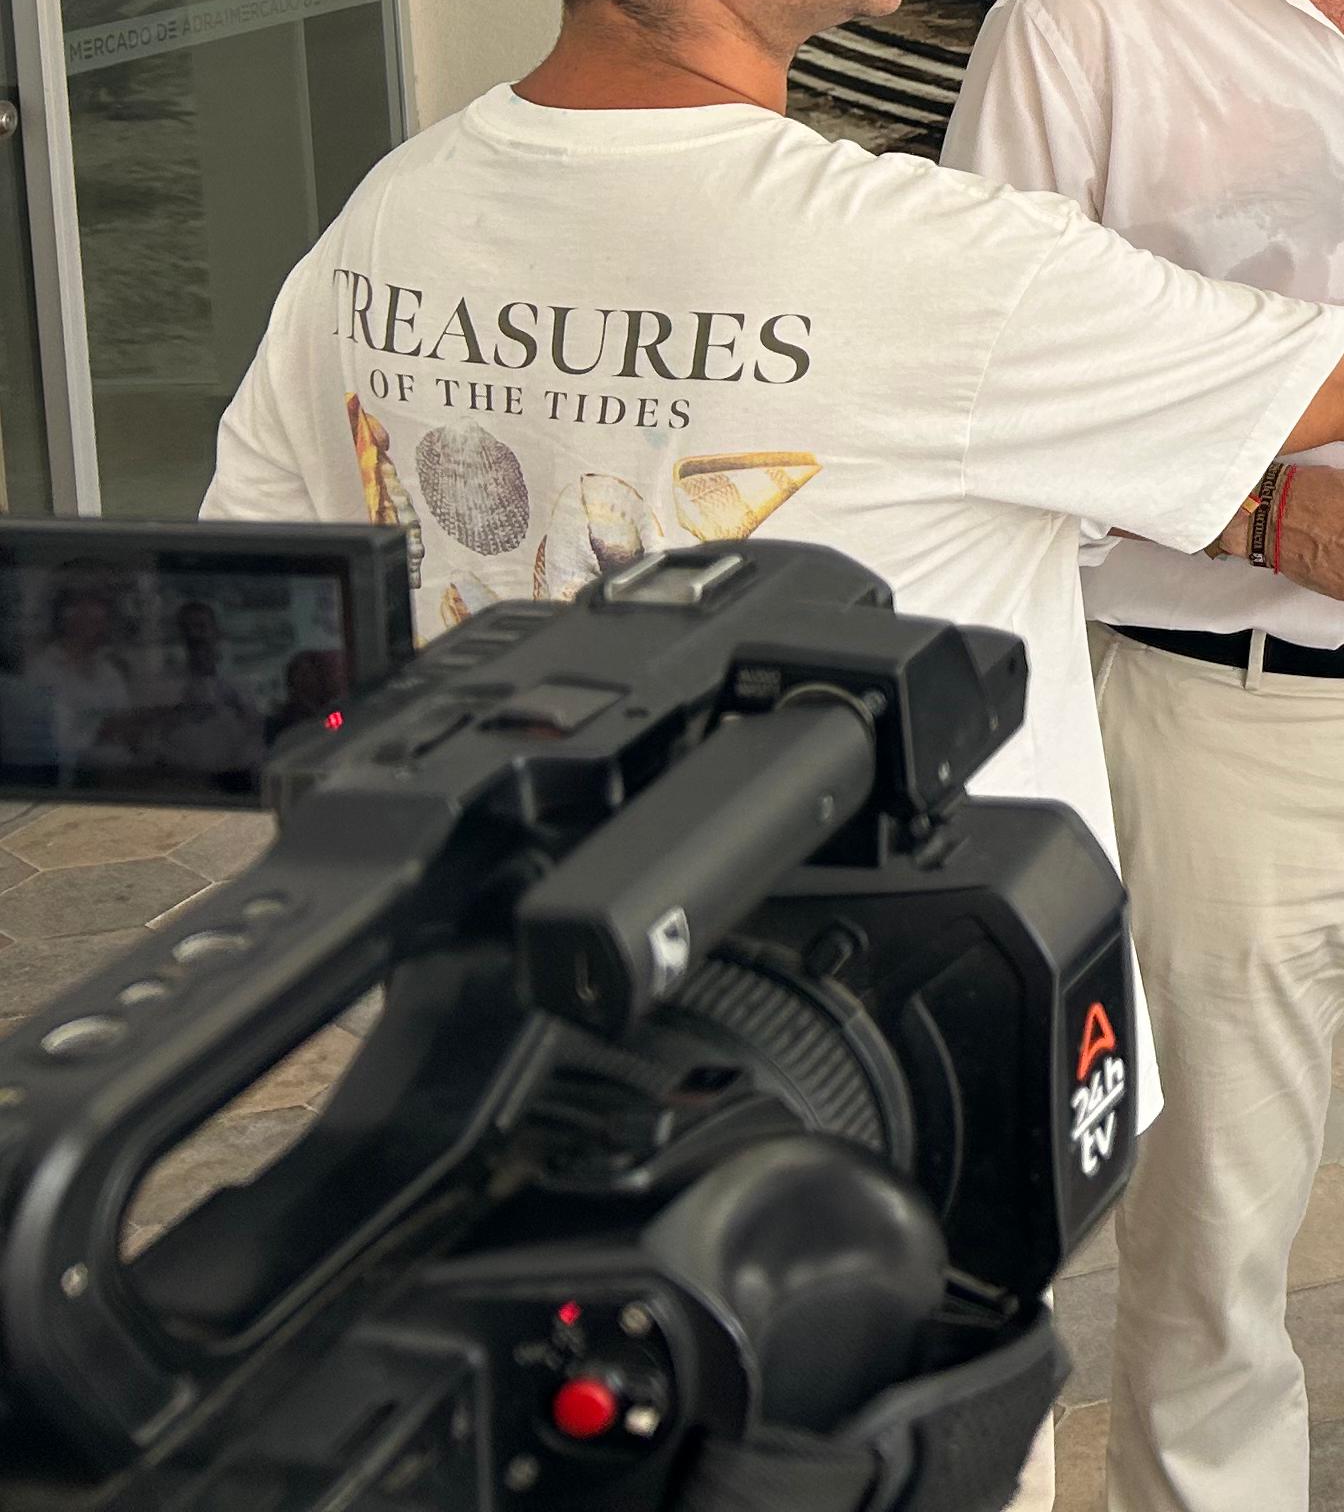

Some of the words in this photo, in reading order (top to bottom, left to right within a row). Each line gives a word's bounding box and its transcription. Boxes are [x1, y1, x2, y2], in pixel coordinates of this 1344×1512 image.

[69, 26, 152, 60] MERCADO
[156, 20, 178, 41] DE
[181, 12, 225, 37] ADRA
[332, 268, 812, 384] TREASURES
[369, 368, 415, 402] OF
[435, 377, 525, 416] THE
[544, 389, 692, 429] TIDES
[1070, 1056, 1125, 1128] 24h
[1080, 1110, 1117, 1176] tv
